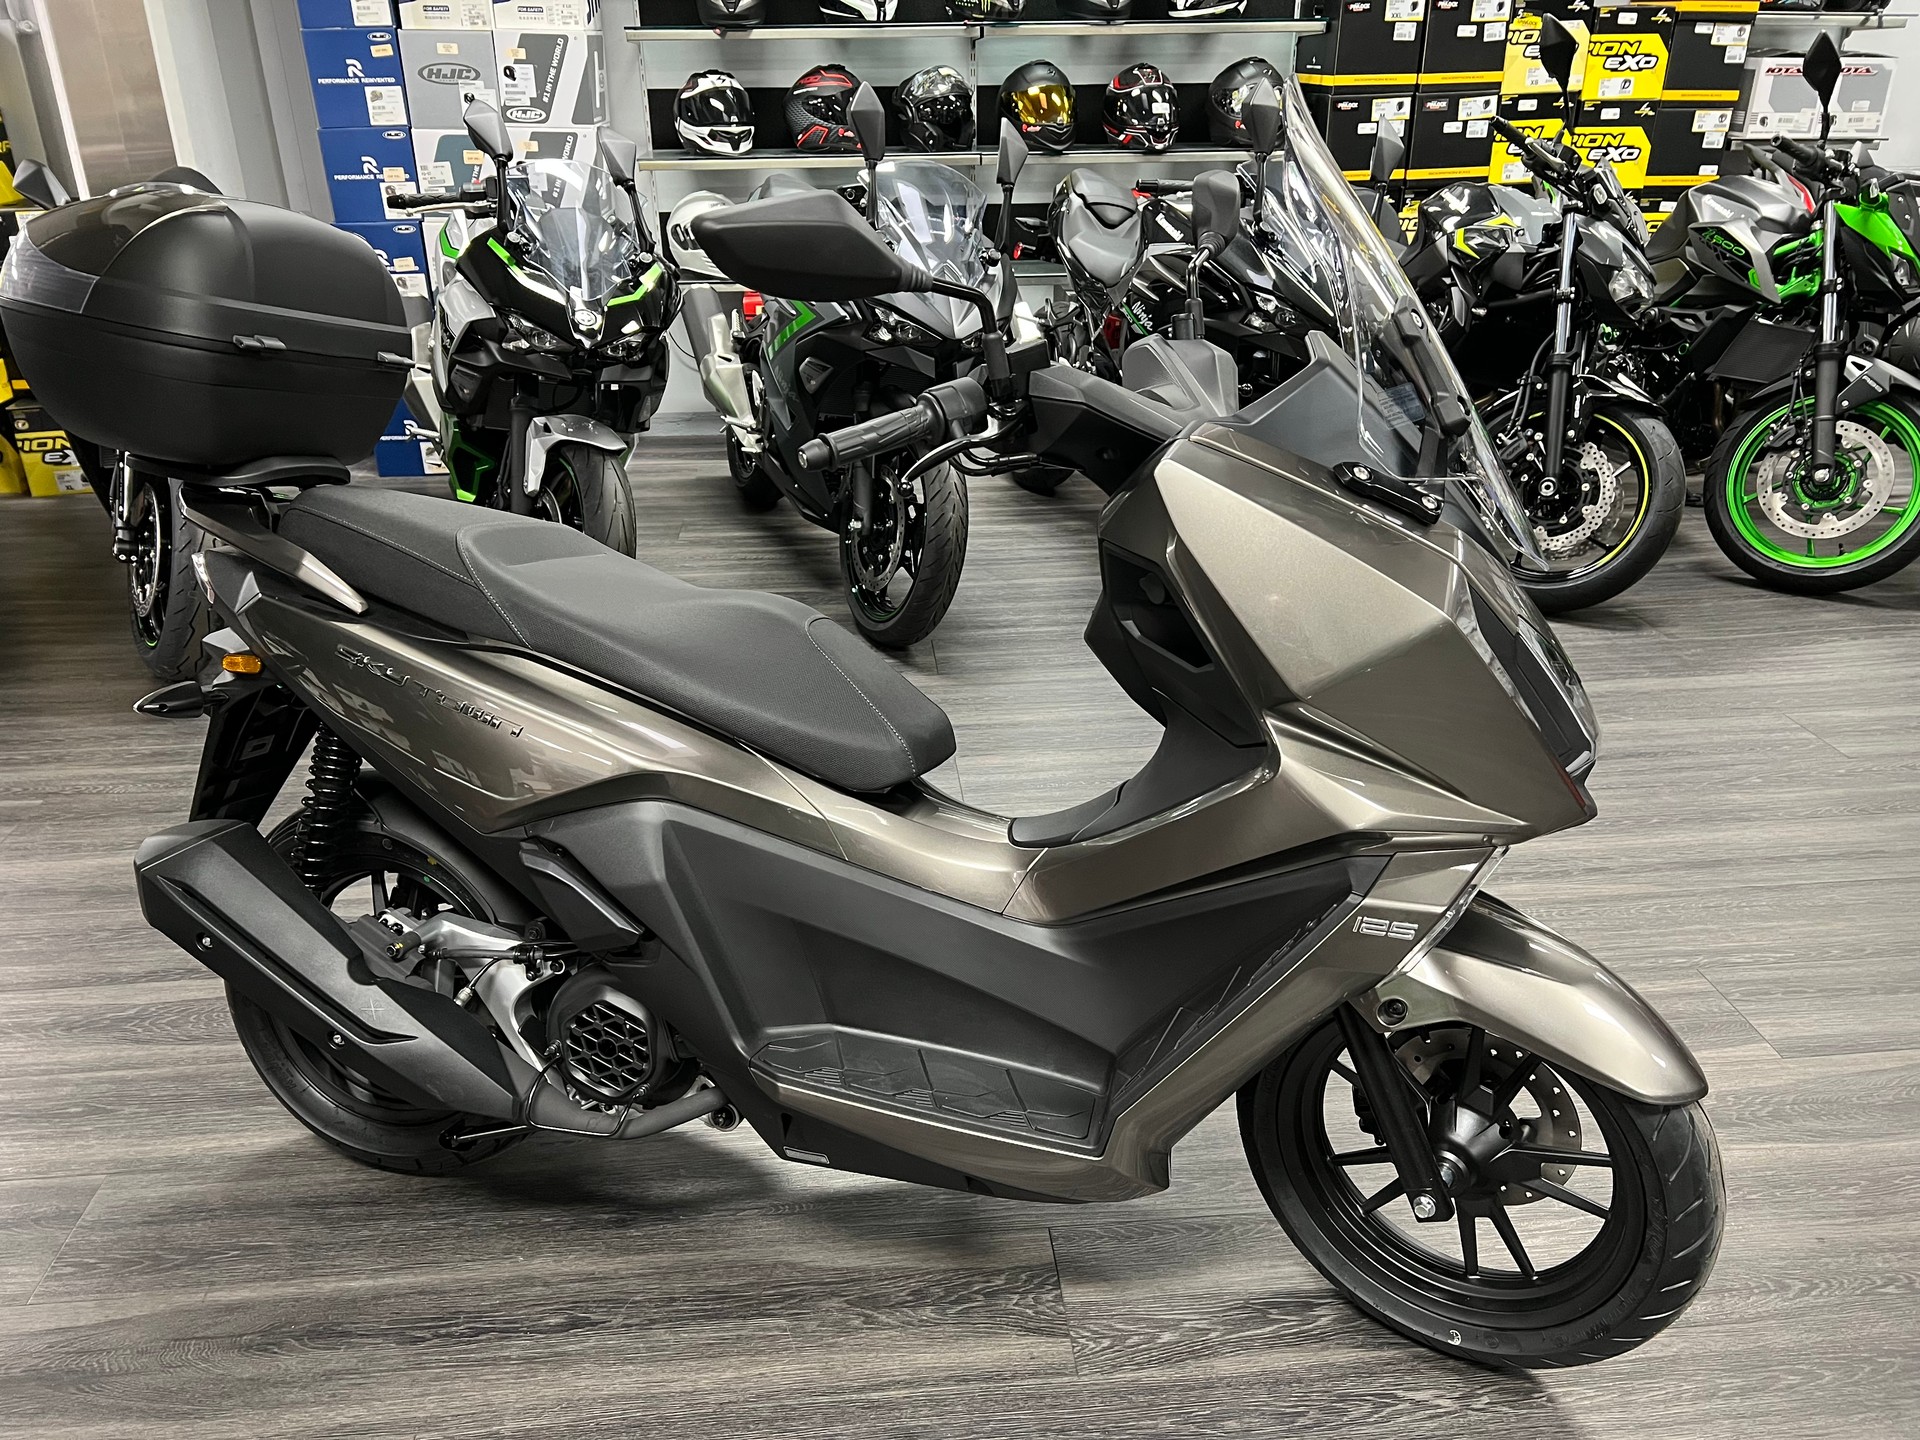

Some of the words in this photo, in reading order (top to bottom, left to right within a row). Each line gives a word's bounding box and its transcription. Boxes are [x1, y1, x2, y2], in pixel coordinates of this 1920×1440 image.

[551, 37, 564, 67] WORLD
[511, 109, 542, 120] HJC
[1131, 300, 1153, 331] Ninja
[1352, 916, 1418, 940] 125
